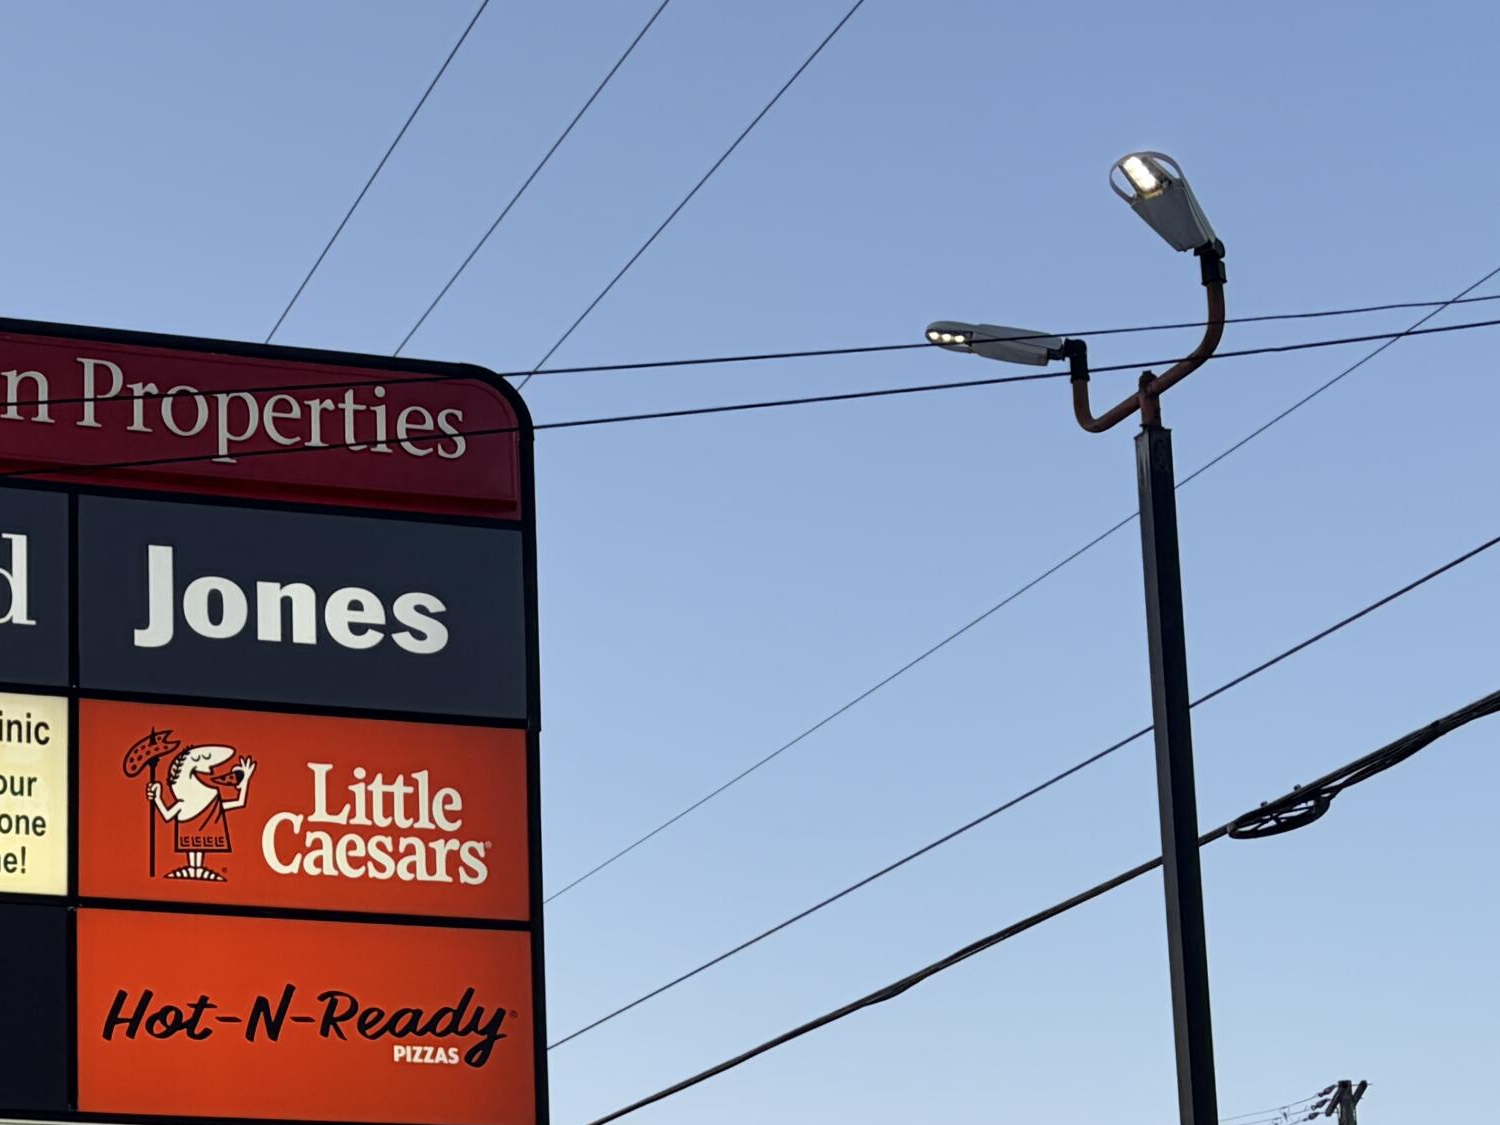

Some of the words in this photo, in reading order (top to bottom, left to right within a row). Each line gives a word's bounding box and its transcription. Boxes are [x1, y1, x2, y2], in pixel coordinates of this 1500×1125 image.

[75, 356, 468, 465] Properties
[134, 543, 450, 655] Jones
[307, 761, 462, 832] Little
[261, 812, 489, 885] Caesars
[102, 983, 508, 1068] Hot-N-Ready
[393, 1044, 459, 1065] PIZZAS
